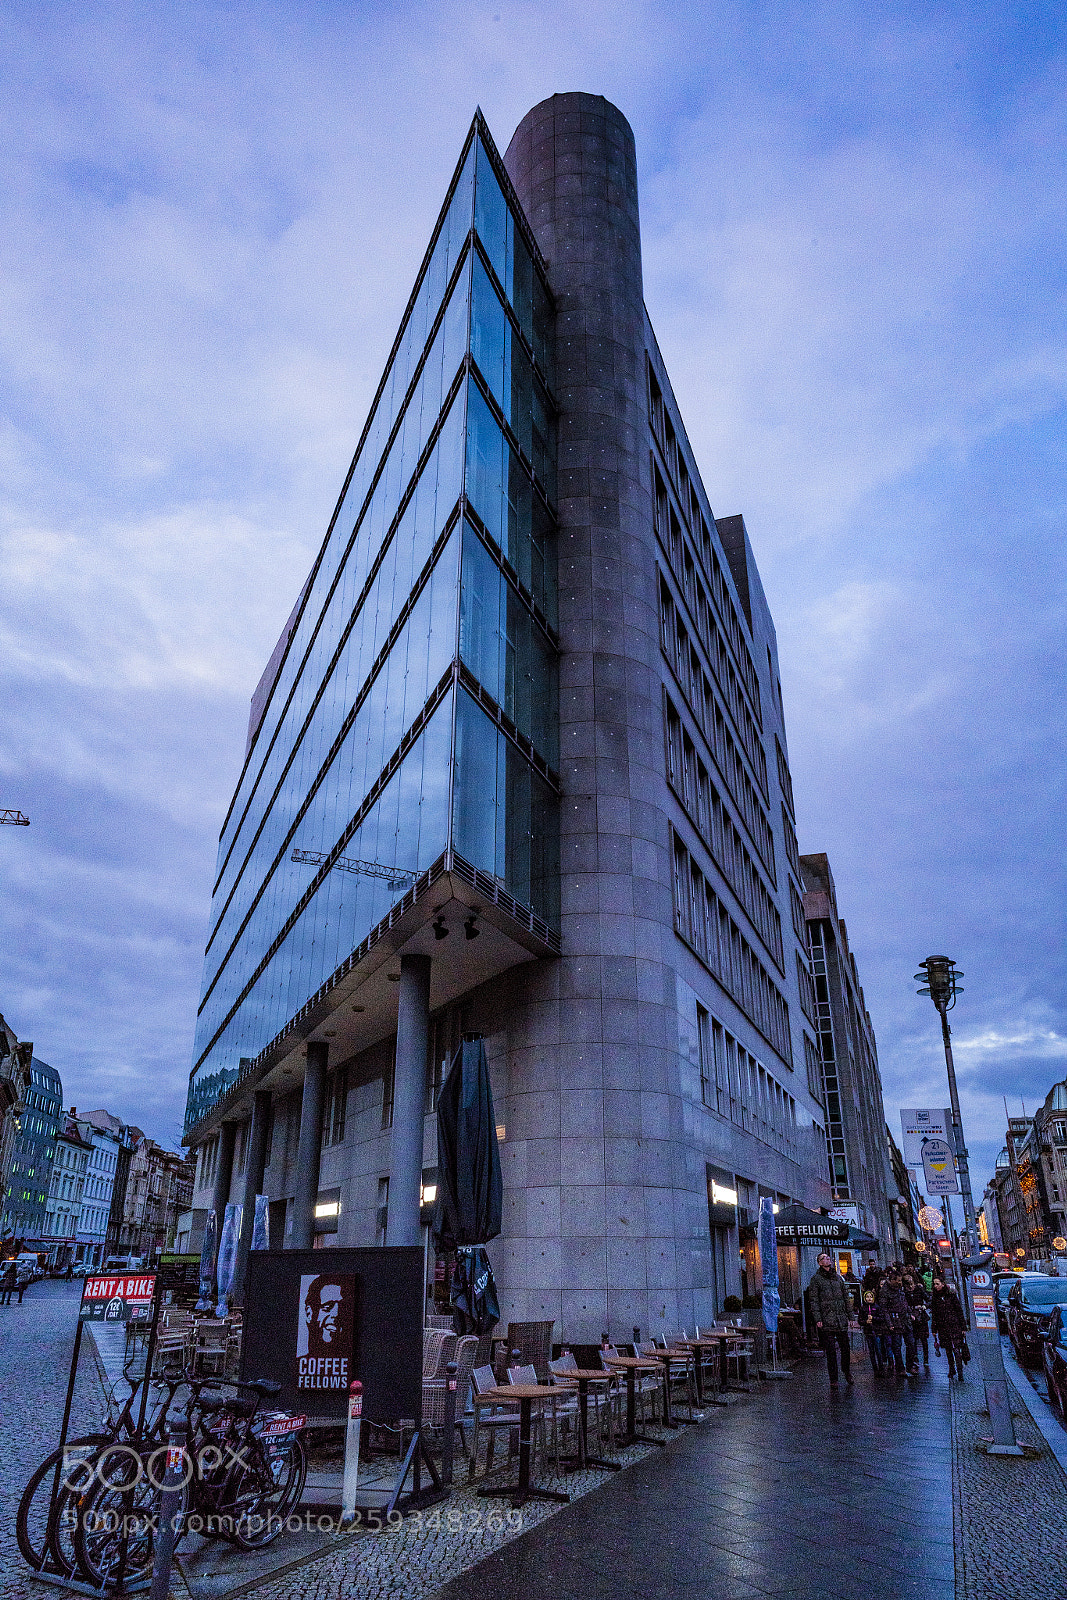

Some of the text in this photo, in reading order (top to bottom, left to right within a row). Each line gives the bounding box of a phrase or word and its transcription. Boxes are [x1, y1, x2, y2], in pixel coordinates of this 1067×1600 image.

[797, 1225, 839, 1236] FELLOWS
[84, 1279, 154, 1297] RENT A BIKE
[299, 1357, 349, 1375] COFFEE
[298, 1376, 348, 1388] FELLOWS
